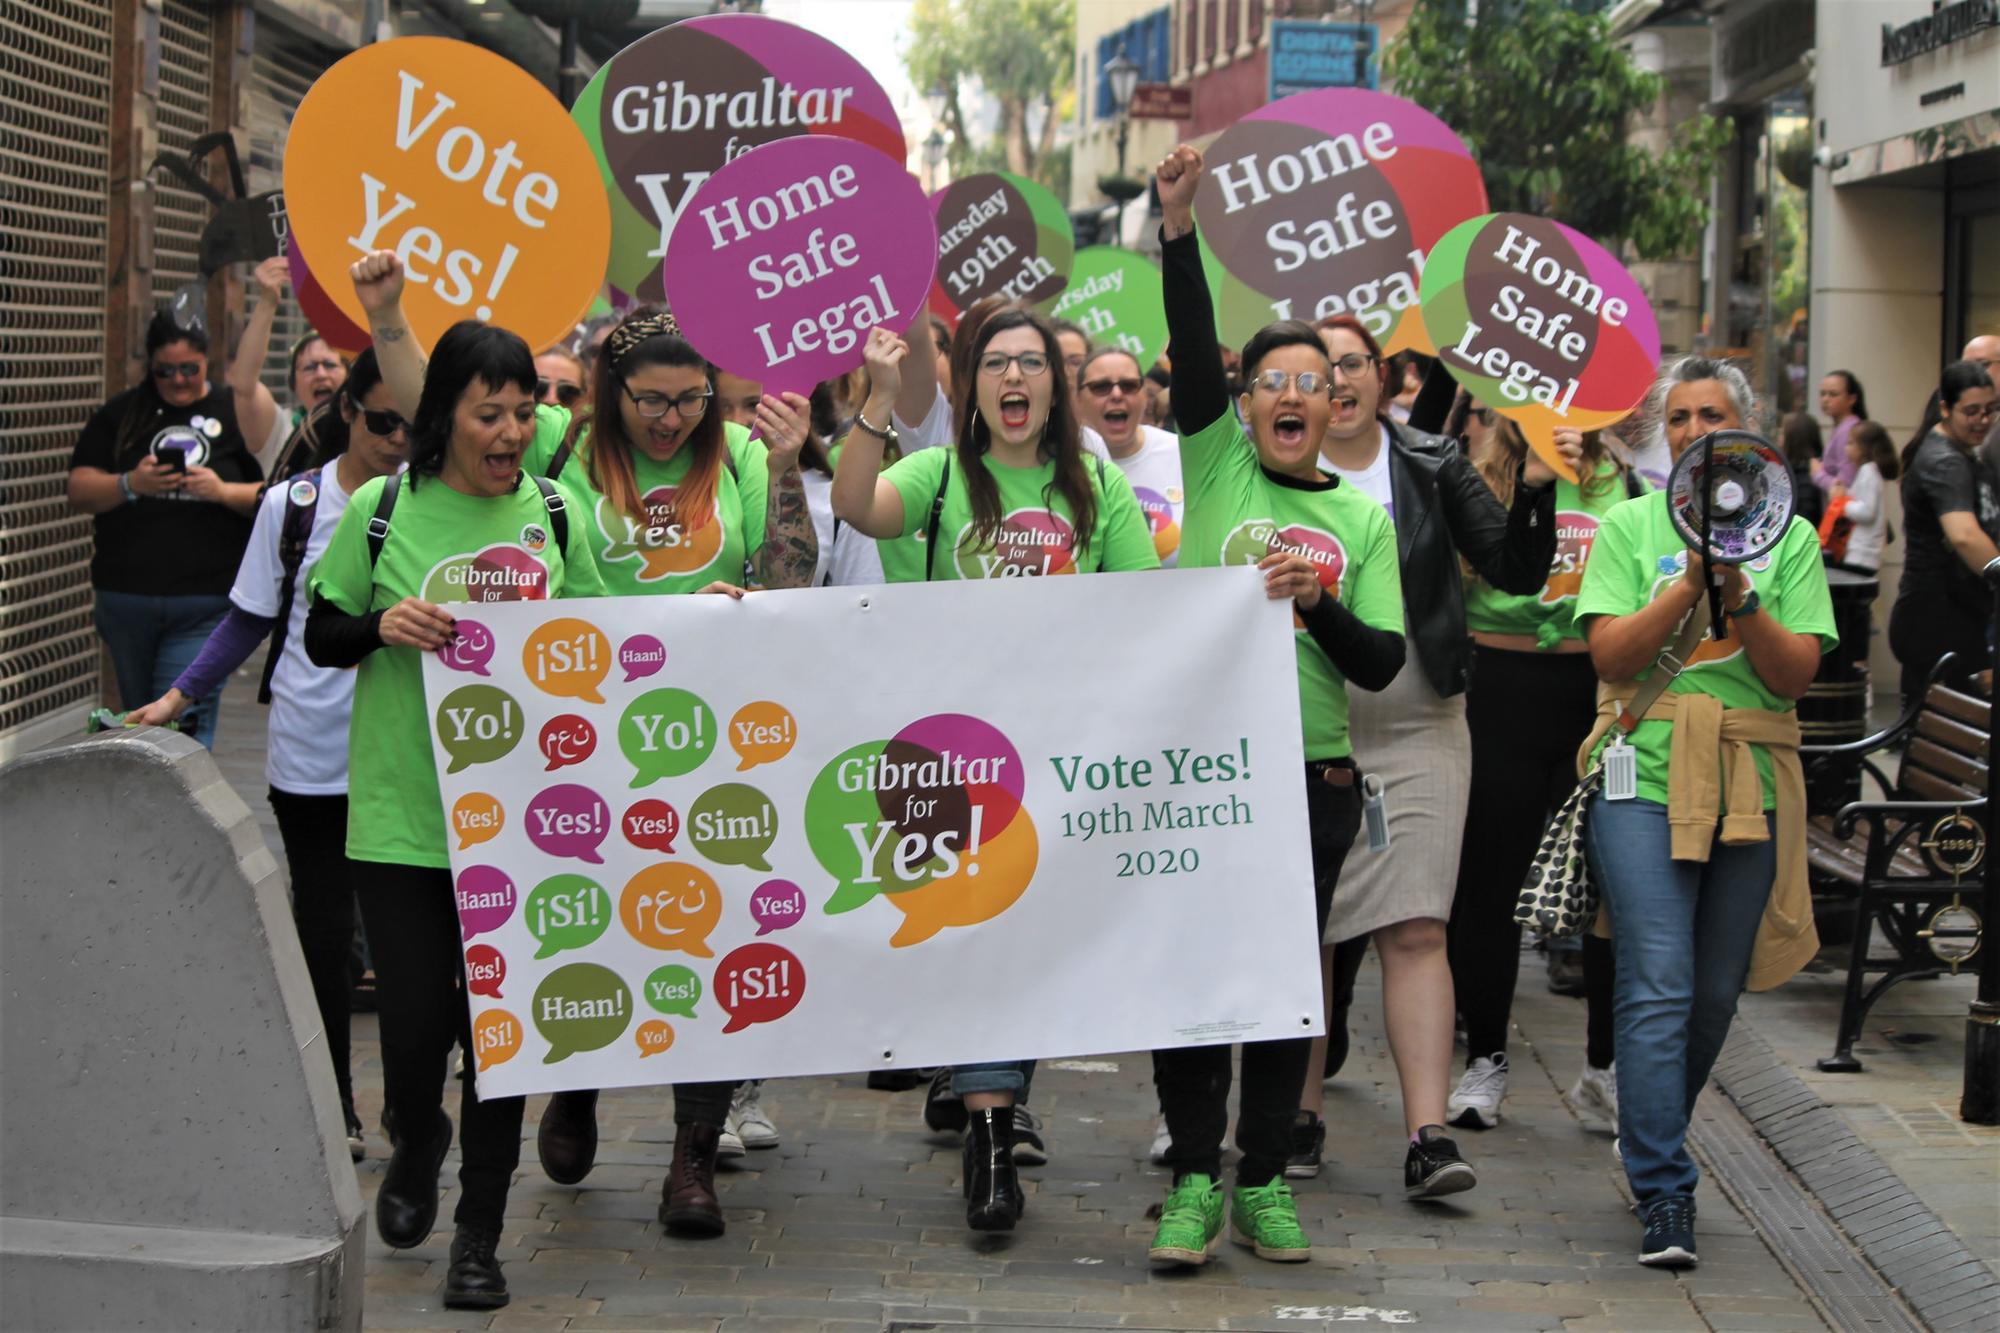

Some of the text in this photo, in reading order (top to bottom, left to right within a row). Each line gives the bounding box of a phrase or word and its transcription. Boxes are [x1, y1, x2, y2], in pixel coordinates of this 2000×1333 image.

[1280, 31, 1354, 51] DIGITA
[612, 77, 853, 133] Gibraltar
[396, 70, 559, 228] Vote
[1211, 121, 1398, 214] Home
[700, 163, 859, 250] Home
[939, 188, 1008, 259] ursday
[347, 173, 519, 321] Yes!
[1266, 192, 1397, 272] Safe
[748, 227, 860, 300] Safe
[947, 234, 1017, 295] 19th
[1493, 225, 1629, 327] Home
[1051, 268, 1125, 316] rsday
[754, 275, 899, 367] Legal
[1077, 306, 1117, 338] th
[1490, 285, 1587, 362] Safe
[1452, 322, 1580, 417] Legal
[980, 527, 1066, 547] braltar
[1250, 525, 1337, 565] Gibraltar
[1557, 525, 1598, 539] altar
[1009, 546, 1028, 560] for
[1550, 544, 1588, 574] es!
[444, 565, 541, 586] Gibraltar
[483, 587, 502, 603] for
[536, 633, 598, 681] ¡Sí!
[622, 646, 663, 663] Haan!
[446, 701, 512, 741] Yo!
[632, 705, 703, 752] Yo!
[735, 715, 791, 746] Yes!
[837, 751, 1007, 793] Gibraltar
[1049, 738, 1252, 793] Vote Yes!
[457, 805, 498, 829] Yes!
[534, 803, 602, 837] Yes!
[628, 811, 674, 836] Yes!
[695, 804, 772, 841] Sim!
[902, 795, 937, 825] for
[1062, 794, 1254, 842] 19th March
[844, 805, 985, 885] Yes!
[1116, 848, 1200, 878] 2020
[457, 884, 512, 910] Haan!
[536, 888, 600, 936] ¡Sí!
[756, 892, 801, 916] Yes!
[466, 957, 501, 981] Yes!
[651, 977, 696, 1000] Yes!
[729, 960, 791, 1008] ¡Sí!
[541, 990, 624, 1022] Haan!
[479, 1021, 512, 1053] ¡Sí!
[643, 1029, 668, 1044] Yo!
